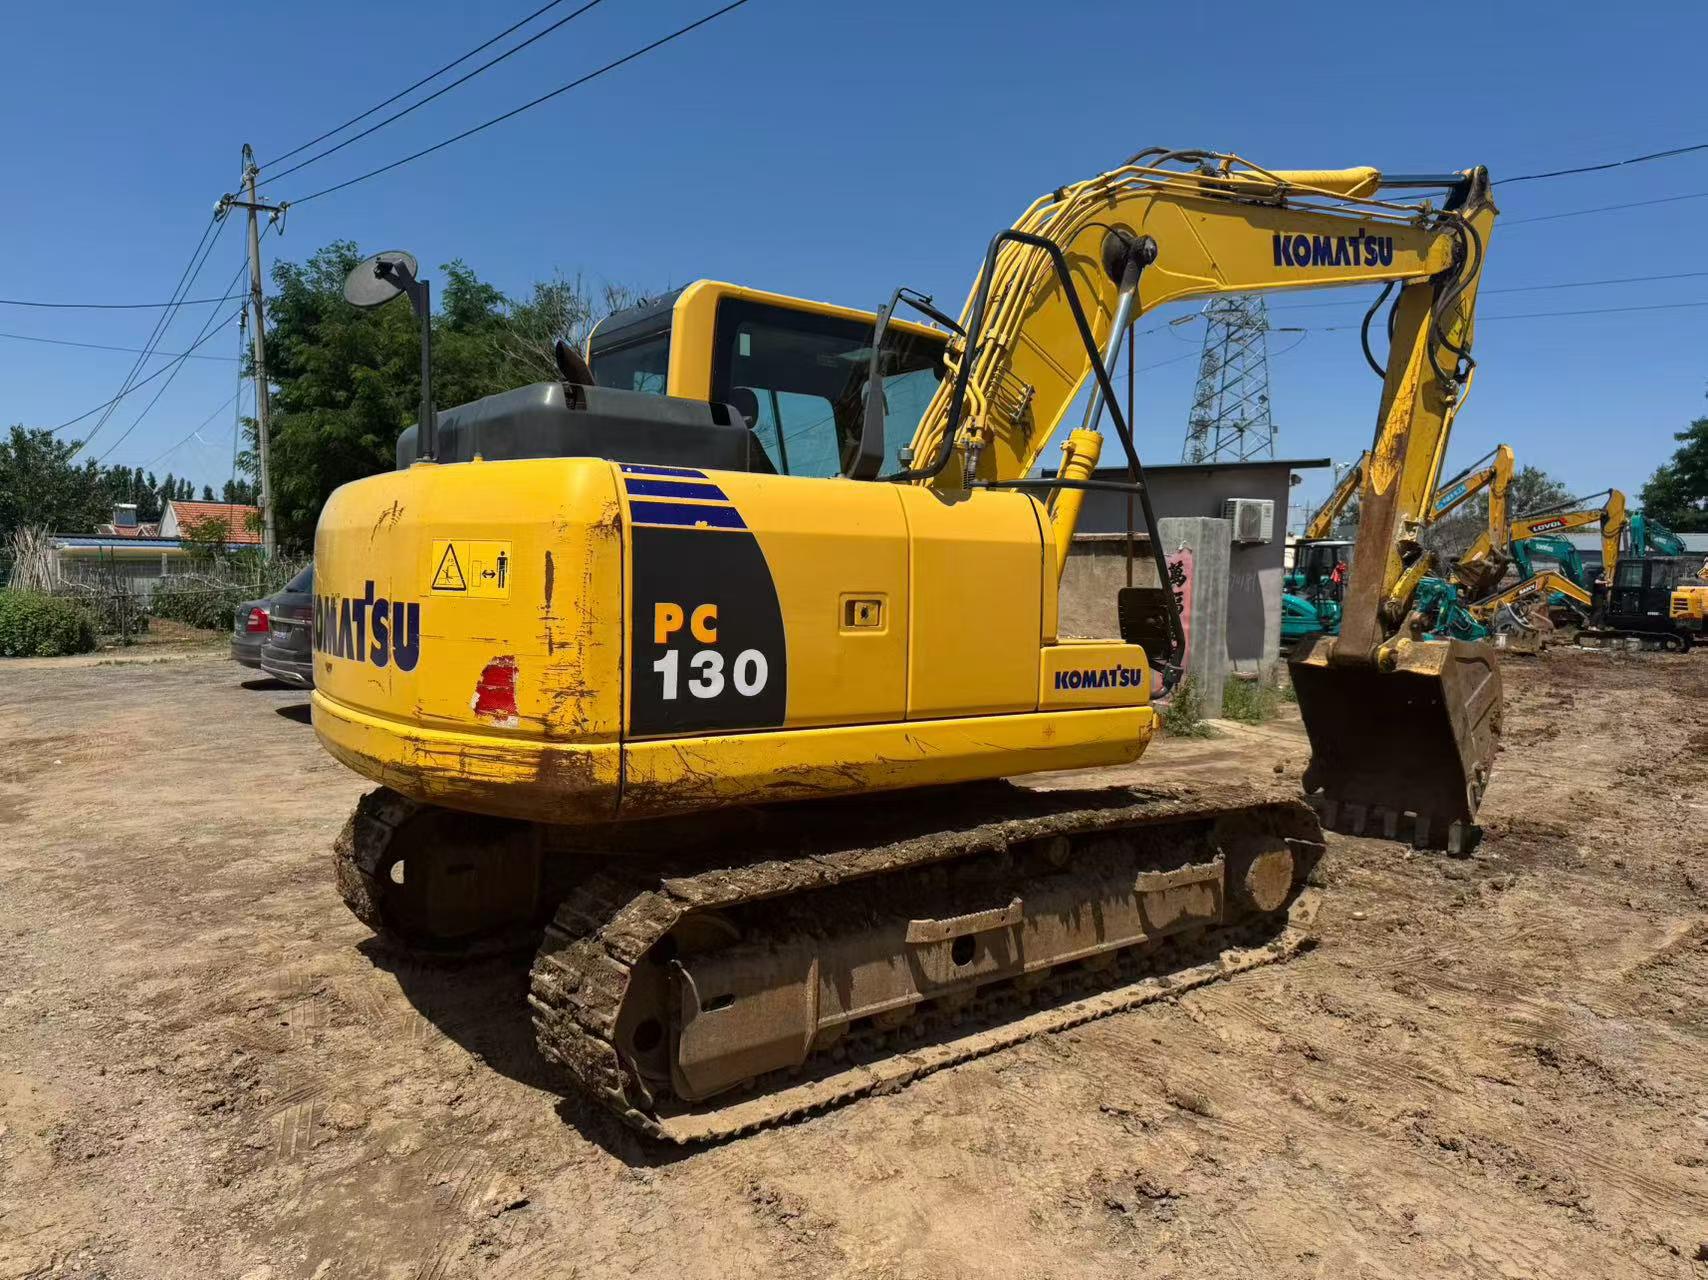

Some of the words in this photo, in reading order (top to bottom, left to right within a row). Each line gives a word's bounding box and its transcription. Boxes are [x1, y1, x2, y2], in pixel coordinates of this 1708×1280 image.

[1273, 228, 1392, 267] KOMATSU
[313, 580, 420, 672] OMATSU
[653, 602, 718, 644] PC
[652, 648, 769, 700] 130
[1055, 664, 1141, 689] KOMATSU
